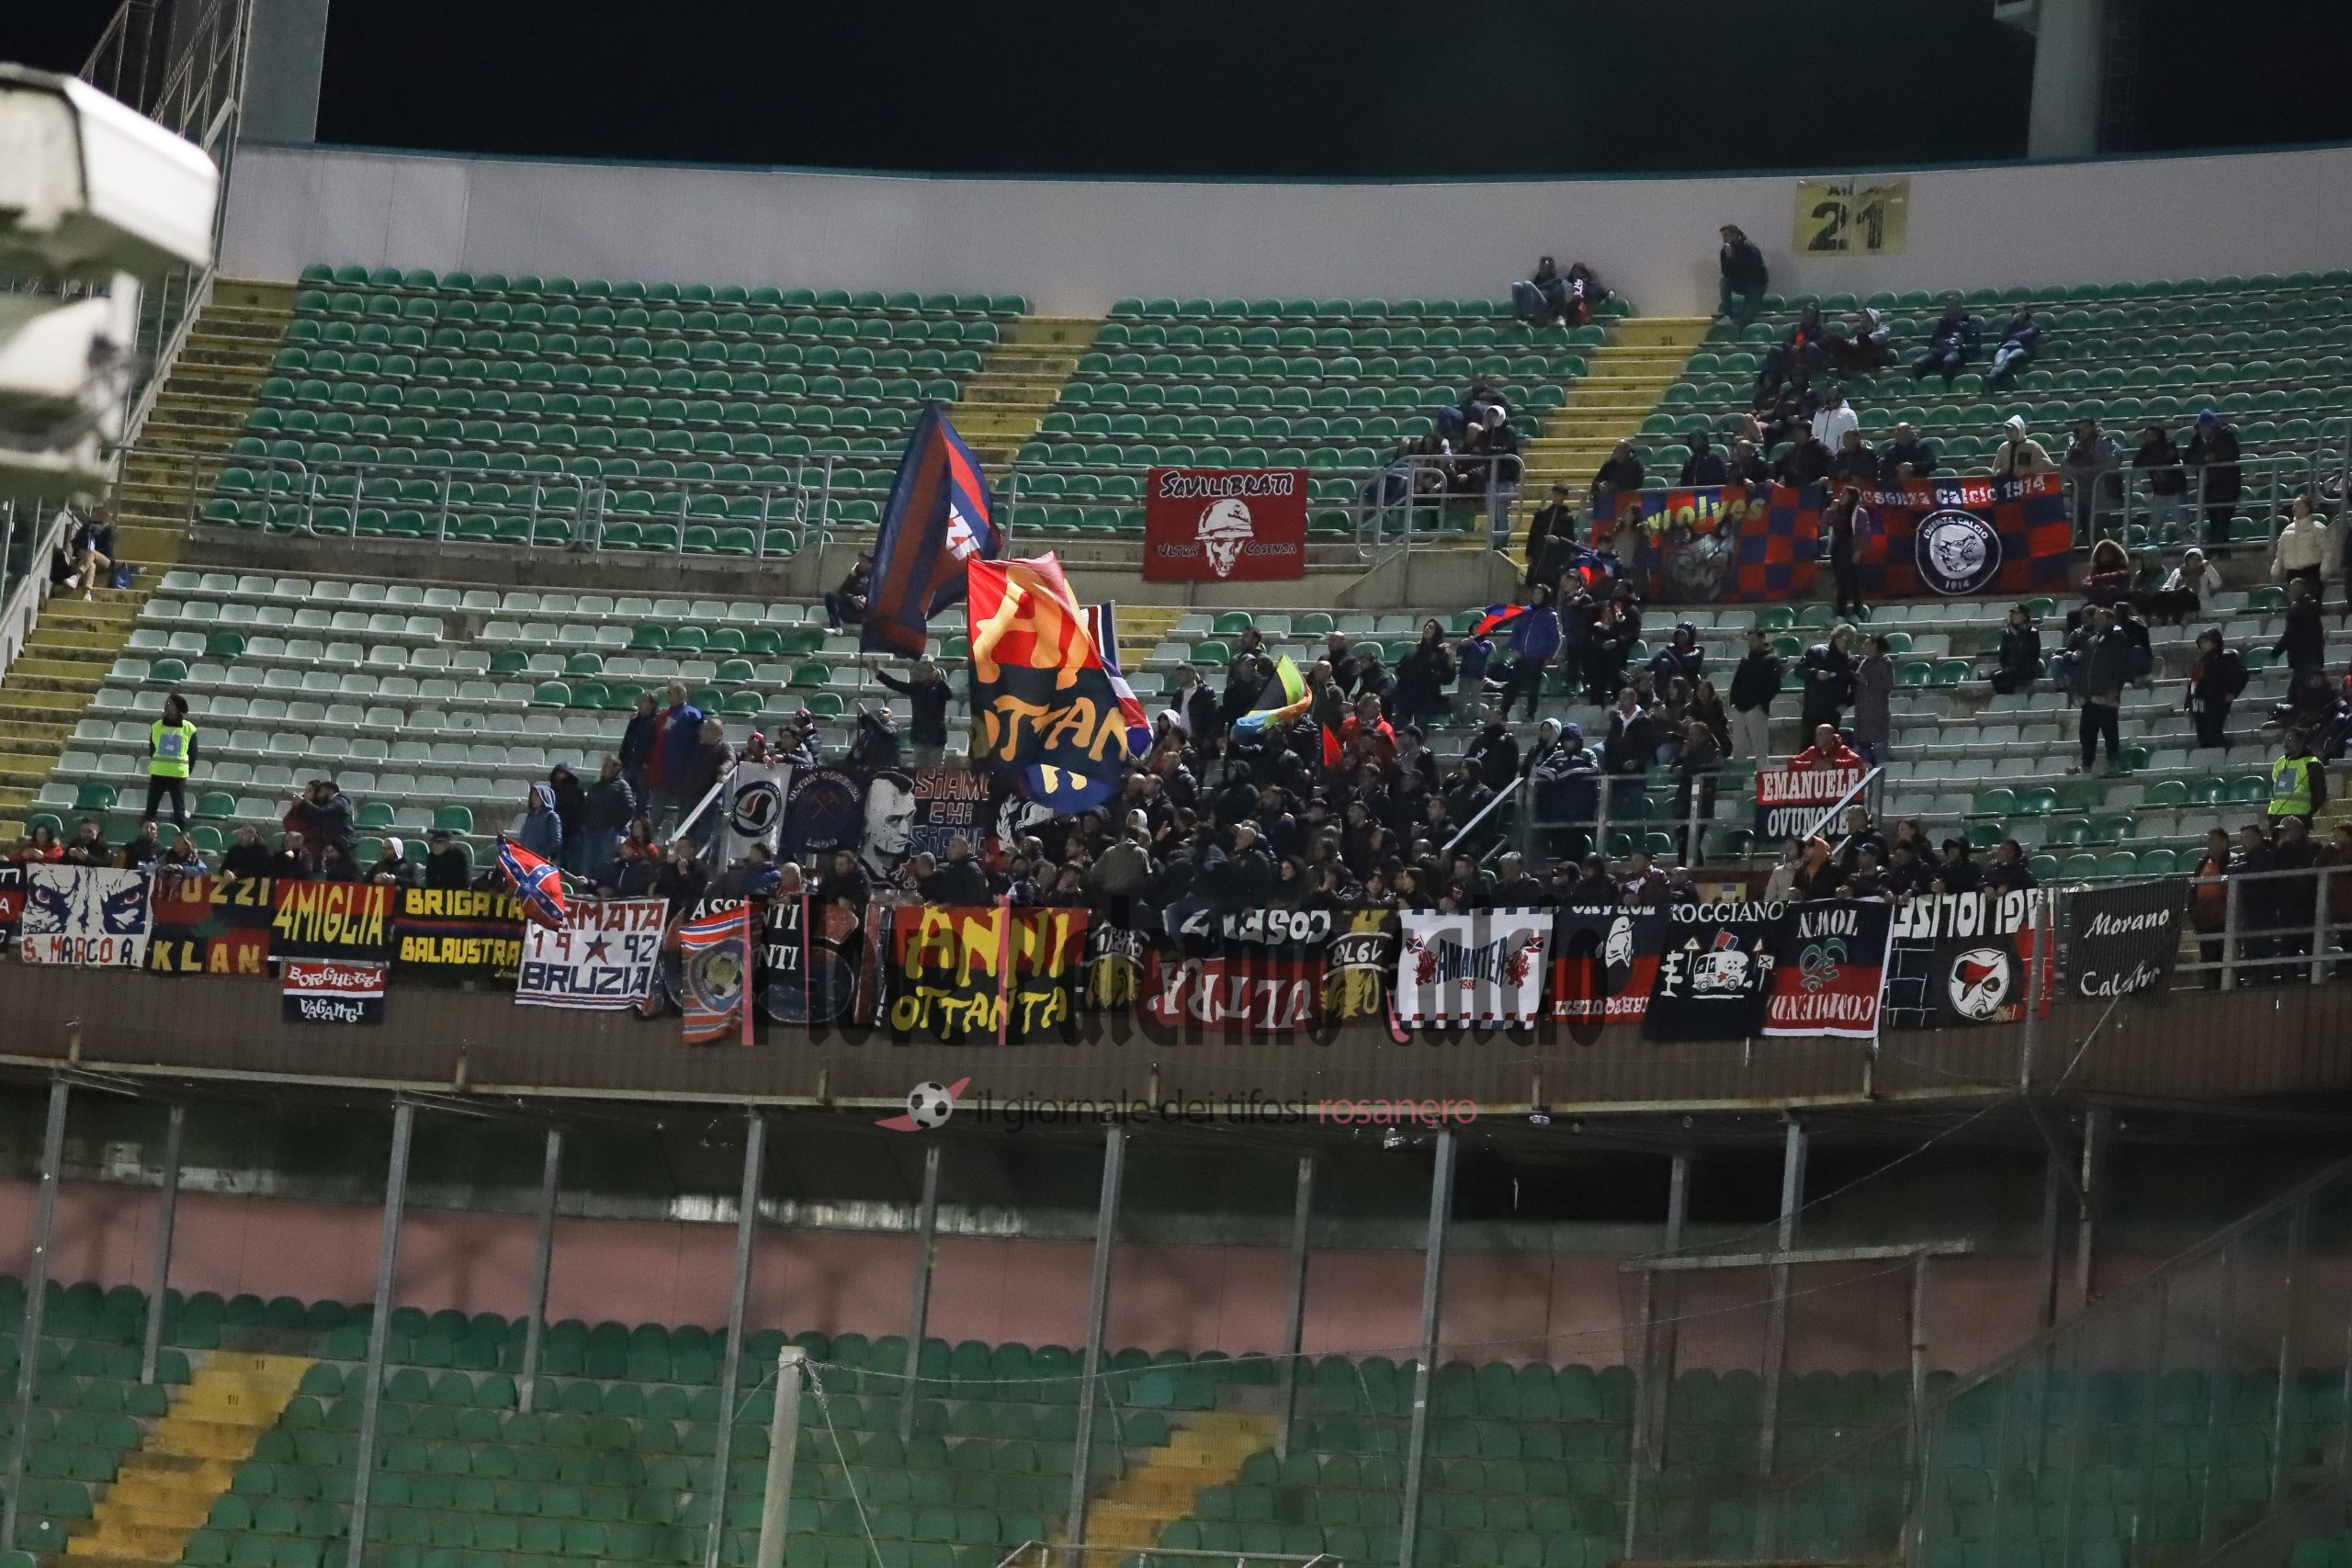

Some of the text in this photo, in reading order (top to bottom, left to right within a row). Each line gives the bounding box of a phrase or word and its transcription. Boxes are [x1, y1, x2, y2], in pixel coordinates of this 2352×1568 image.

[1808, 199, 1883, 252] 21
[2004, 475, 2045, 499] 1914
[1957, 516, 1989, 540] CALCIO
[1945, 580, 1971, 590] 1914
[1762, 768, 1859, 801] EMANUELE
[405, 887, 526, 921] BRIGATA
[560, 901, 665, 931] RMATA
[2084, 908, 2170, 939] Morano
[50, 935, 113, 964] MARCO
[151, 940, 261, 975] KLAN
[400, 936, 522, 967] BALAUSTRA
[905, 906, 1069, 988] ANNI
[1332, 940, 1384, 966] 1978
[1437, 936, 1508, 987] AMANTEA
[287, 964, 382, 988] BORGHETTI
[521, 961, 651, 995] BRUZIA
[300, 998, 364, 1023] VAGANTI
[891, 986, 1068, 1041] OTTANTA
